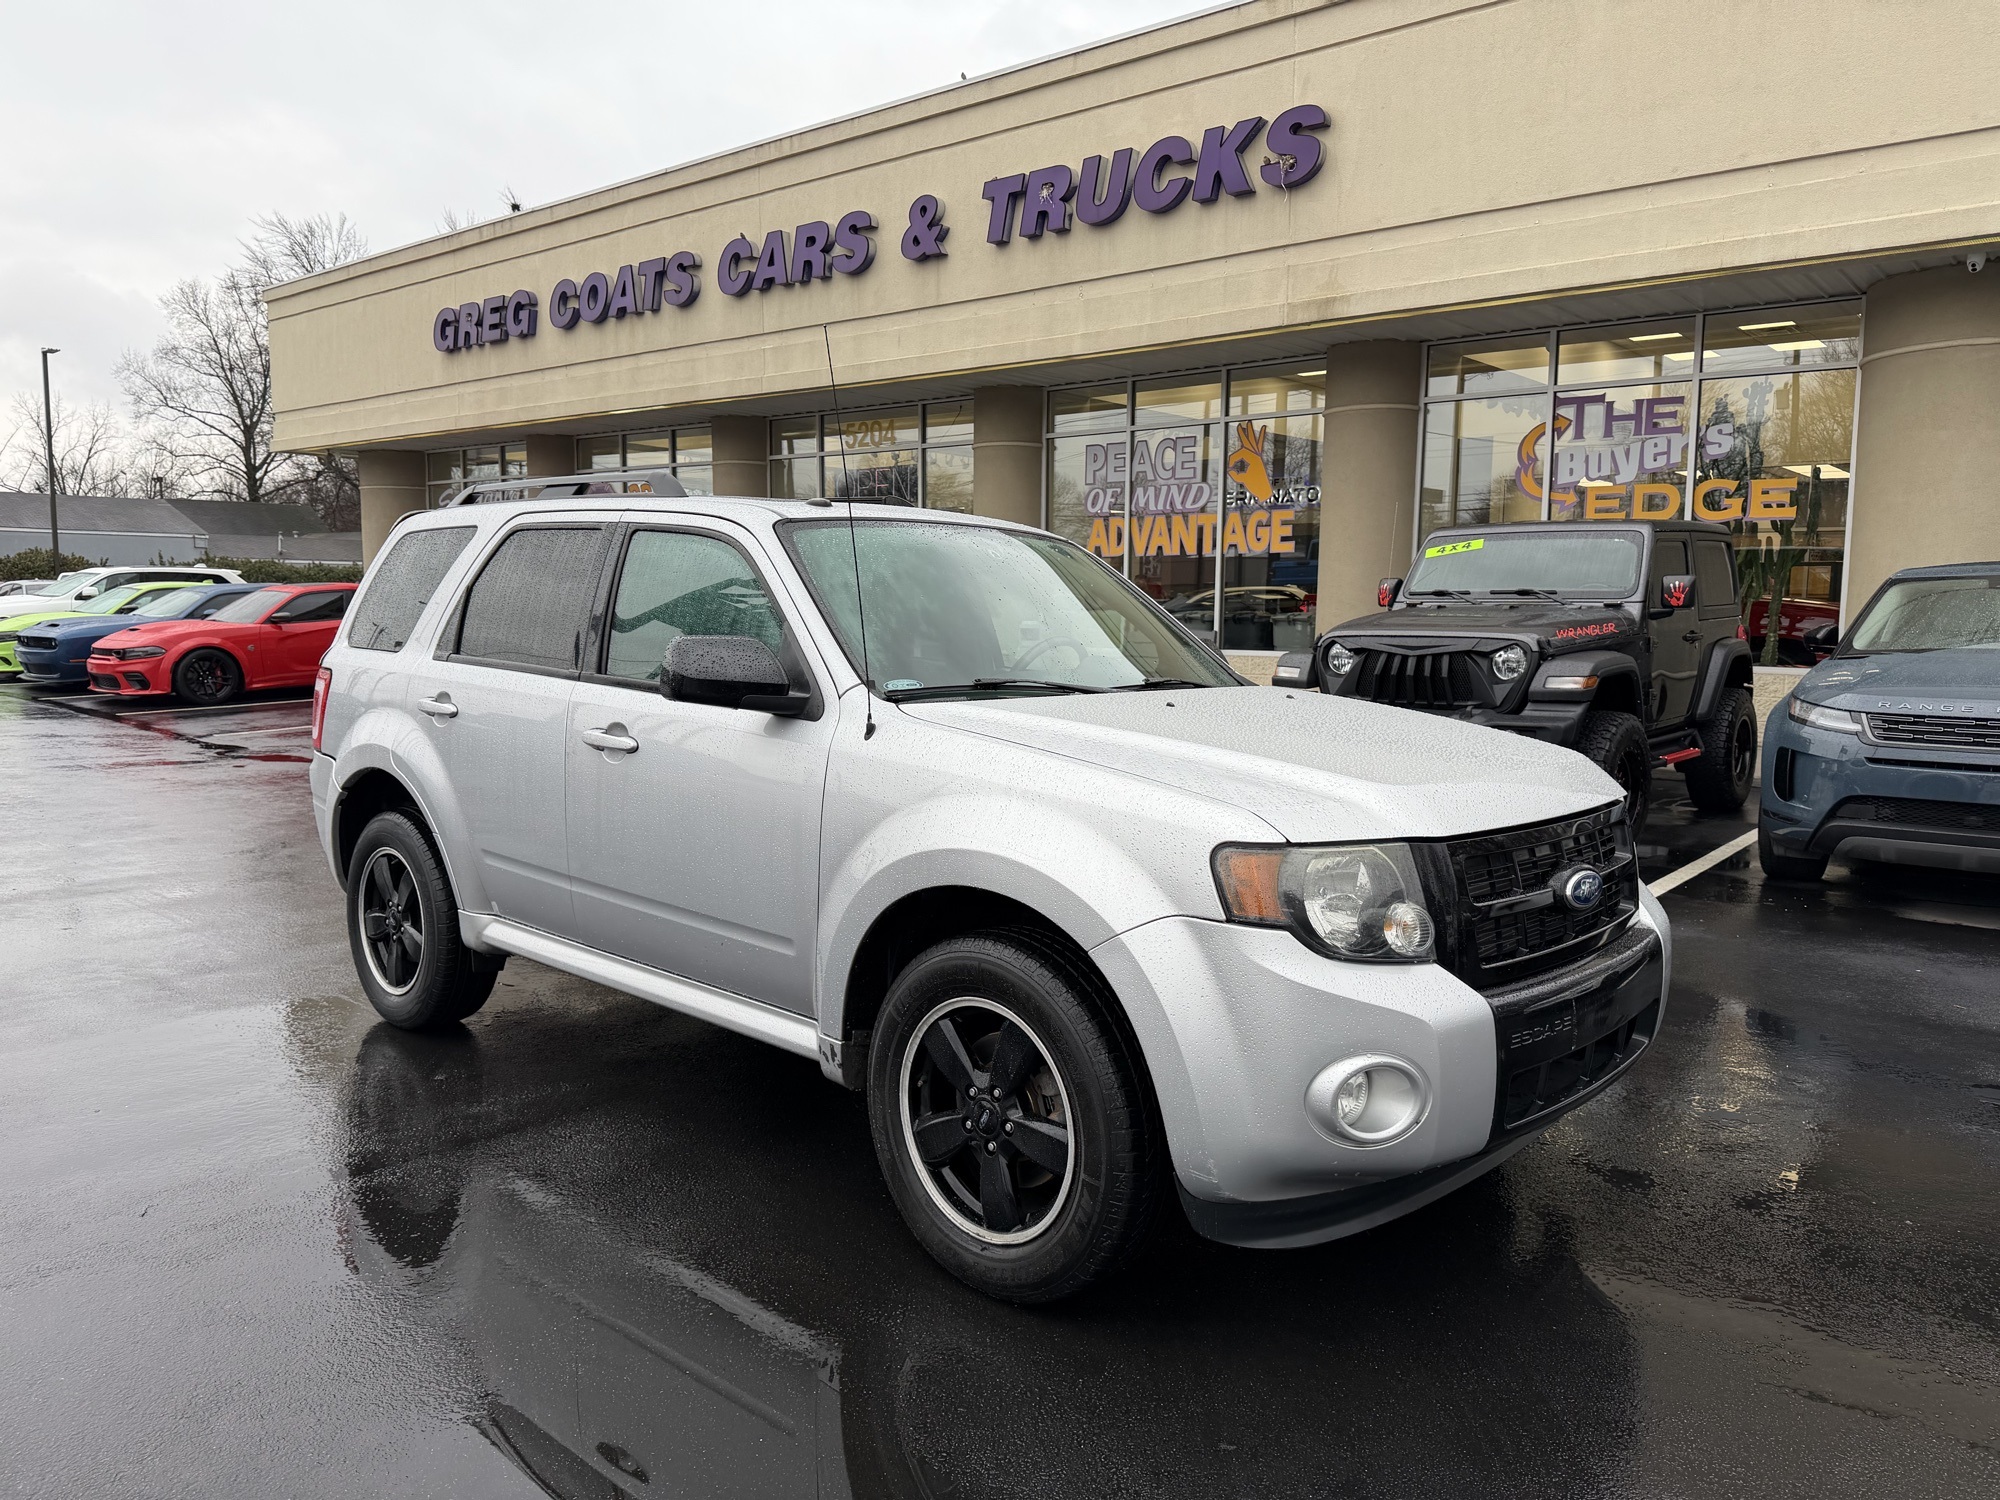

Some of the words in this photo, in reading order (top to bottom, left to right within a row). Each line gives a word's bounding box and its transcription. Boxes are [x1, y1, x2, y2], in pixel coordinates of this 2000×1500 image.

[433, 289, 538, 353] GREG
[549, 250, 702, 330] COATS
[717, 210, 878, 297] CARS
[901, 194, 949, 262] &
[982, 104, 1331, 245] TRUCKS
[844, 419, 897, 449] 5204
[1555, 393, 1685, 440] THE
[1085, 436, 1197, 485] PEACE
[836, 465, 911, 501] OPEN
[1085, 487, 1122, 514] OF
[1131, 483, 1211, 515] MIND
[1584, 477, 1798, 522] EDGE
[1087, 509, 1296, 558] ADVANTAGE
[1556, 622, 1619, 639] WRANGLER
[1878, 701, 1975, 713] RANGE
[1510, 1015, 1572, 1049] ESCAPE
